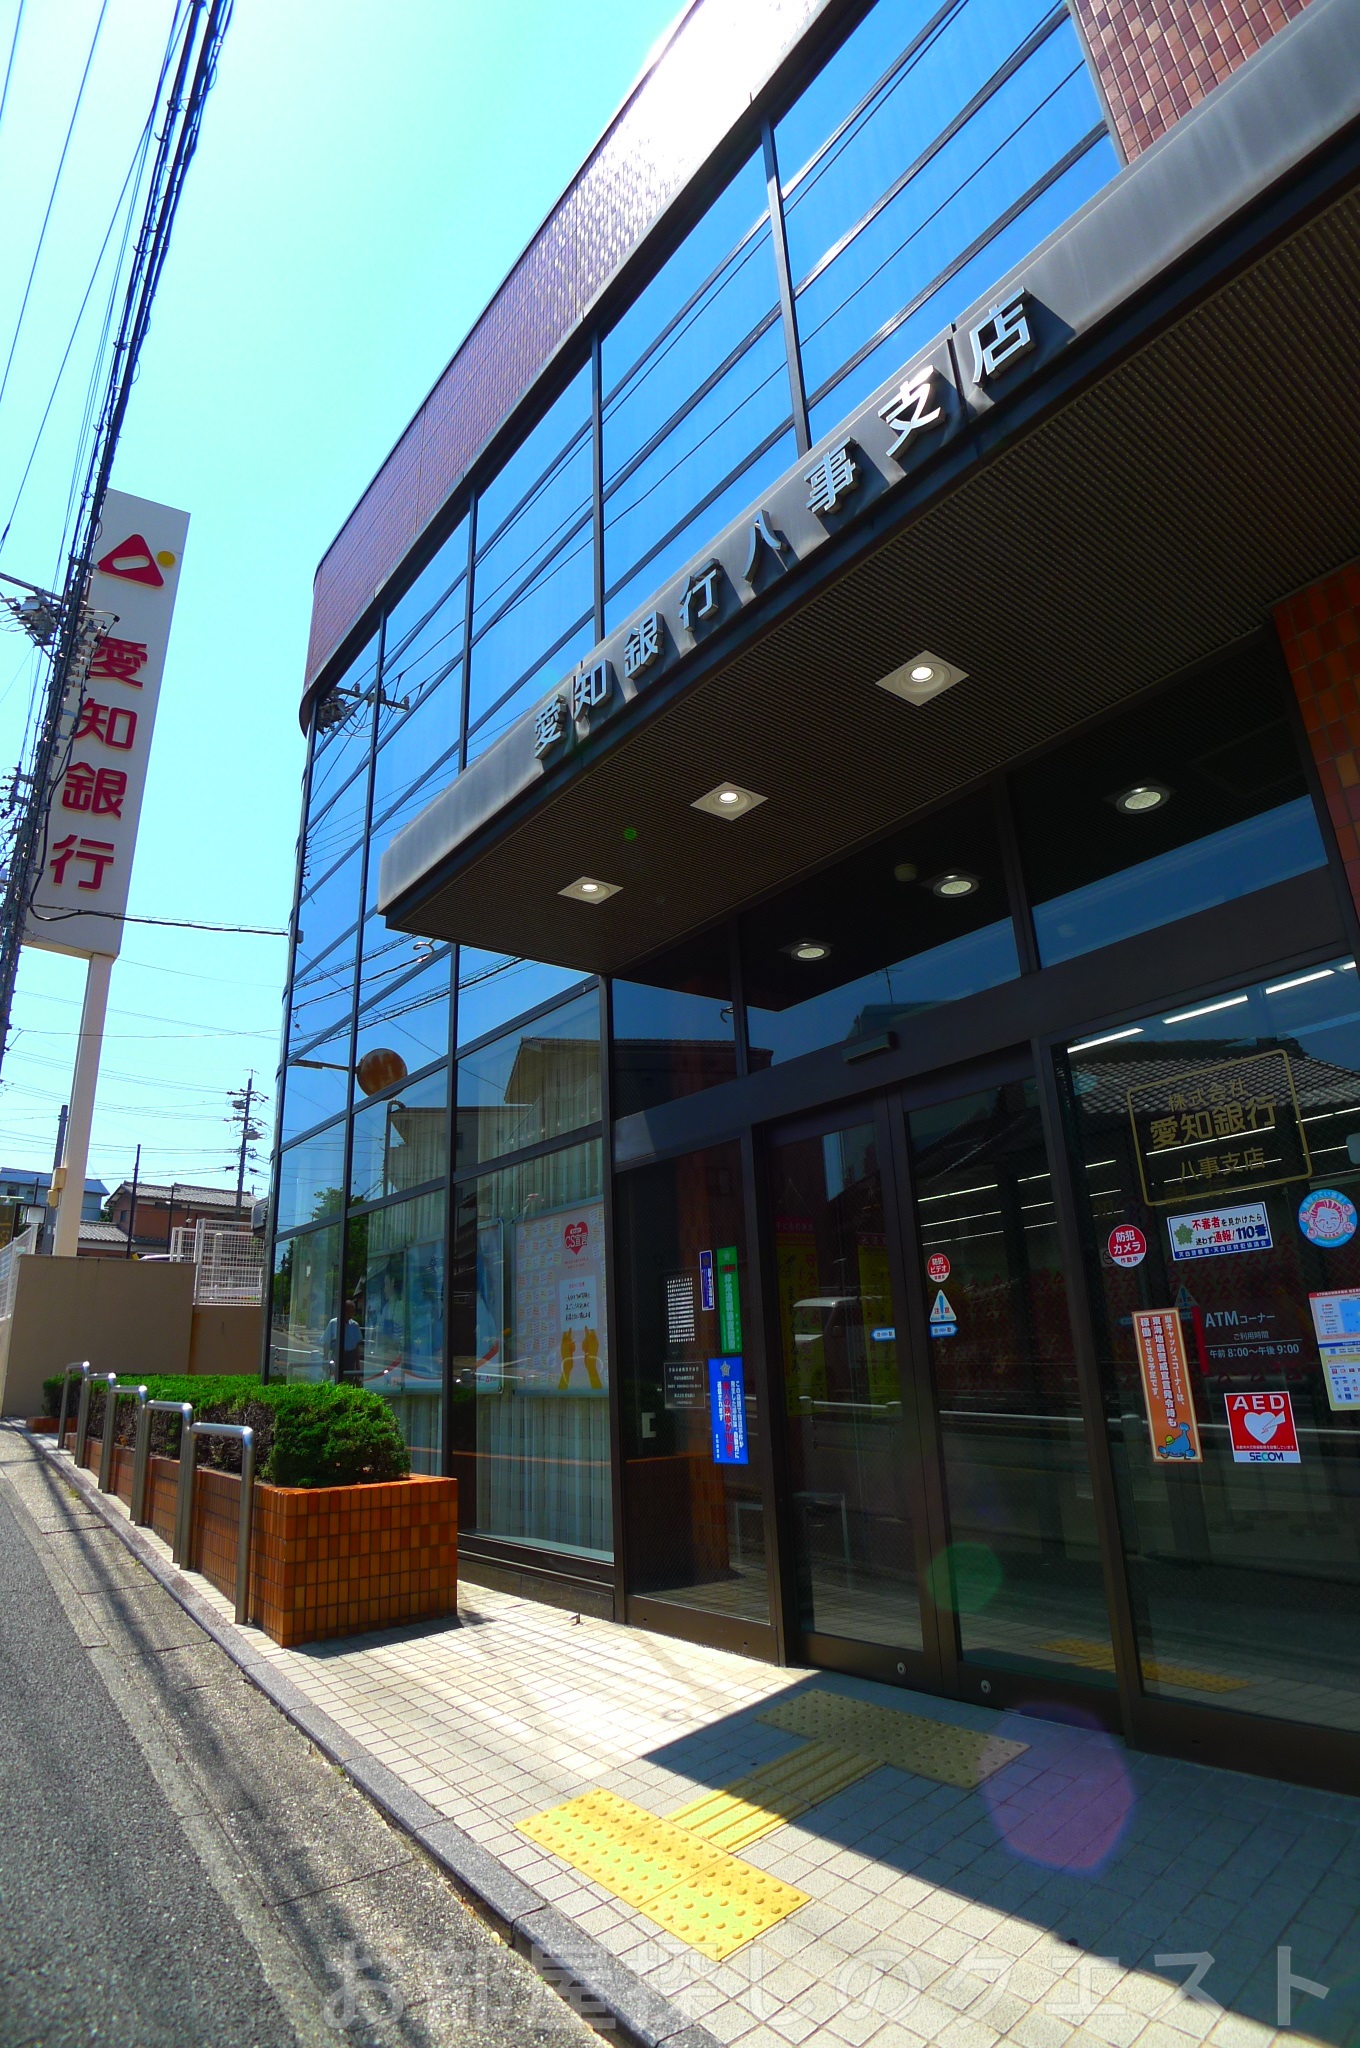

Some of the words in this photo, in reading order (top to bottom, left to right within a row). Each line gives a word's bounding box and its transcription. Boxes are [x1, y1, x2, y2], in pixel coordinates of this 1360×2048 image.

[534, 287, 1034, 760] 愛知銀行八事支店
[50, 636, 148, 890] 愛知銀行
[1168, 1077, 1247, 1113] 株式会社
[1150, 1095, 1277, 1150] 愛知銀行
[1179, 1147, 1266, 1184] 八事支店
[1191, 1213, 1263, 1231] 不審者を見かけたら
[1115, 1230, 1136, 1243] 防犯
[1113, 1241, 1141, 1255] カメラ
[930, 1265, 947, 1274] ビデオ
[1205, 1310, 1276, 1328] ATMコーナー
[1233, 1330, 1269, 1341] ご利用時間
[1232, 1395, 1285, 1411] AED
[1249, 1452, 1284, 1461] SECOM
